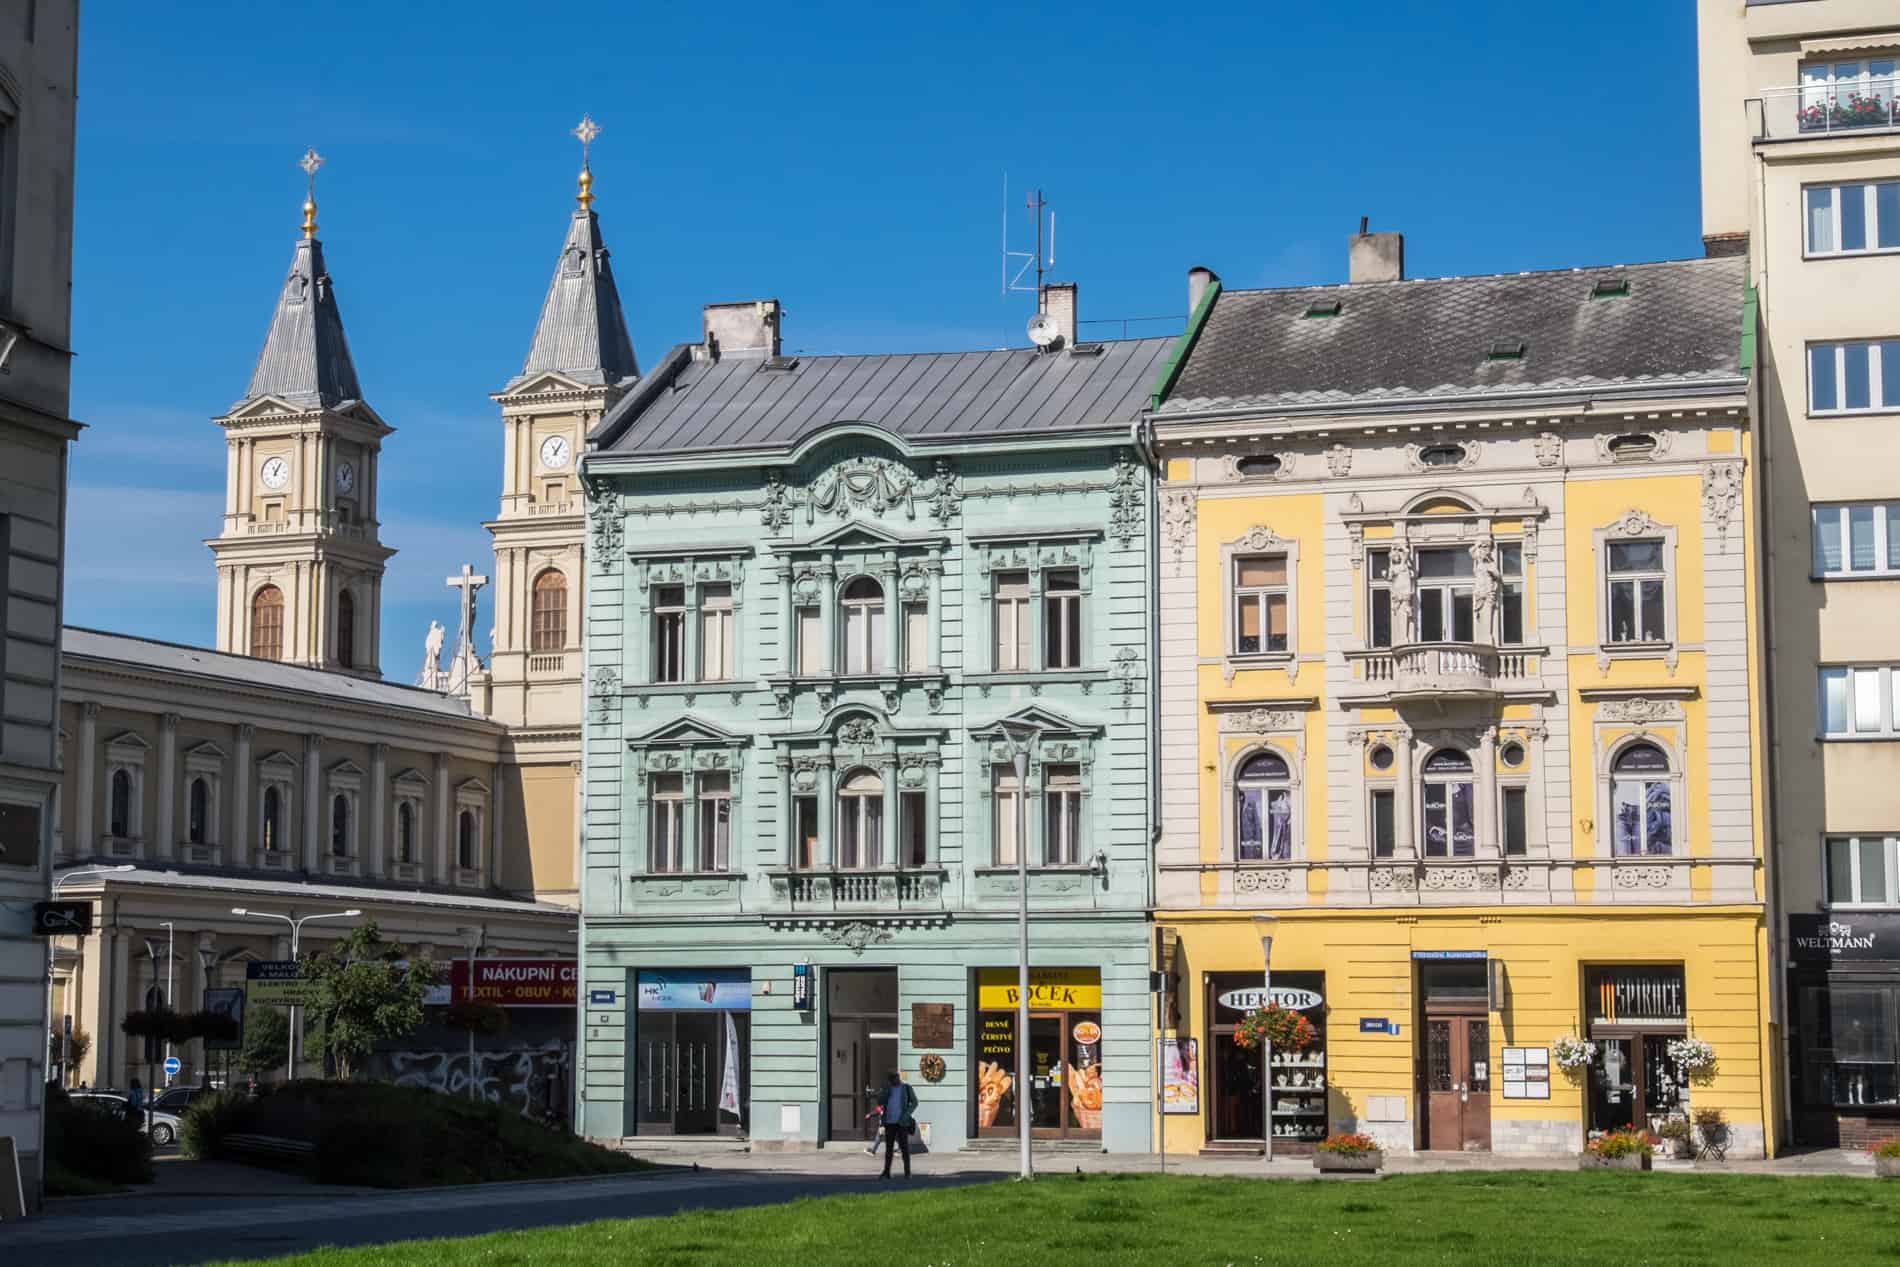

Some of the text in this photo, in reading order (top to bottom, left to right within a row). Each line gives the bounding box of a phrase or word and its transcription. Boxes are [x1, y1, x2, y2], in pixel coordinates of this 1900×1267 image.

[1797, 937, 1873, 949] WELTMANN
[482, 963, 577, 982] NÁKUPNÍ CE
[515, 985, 552, 999] OBUV
[562, 985, 577, 999] KO
